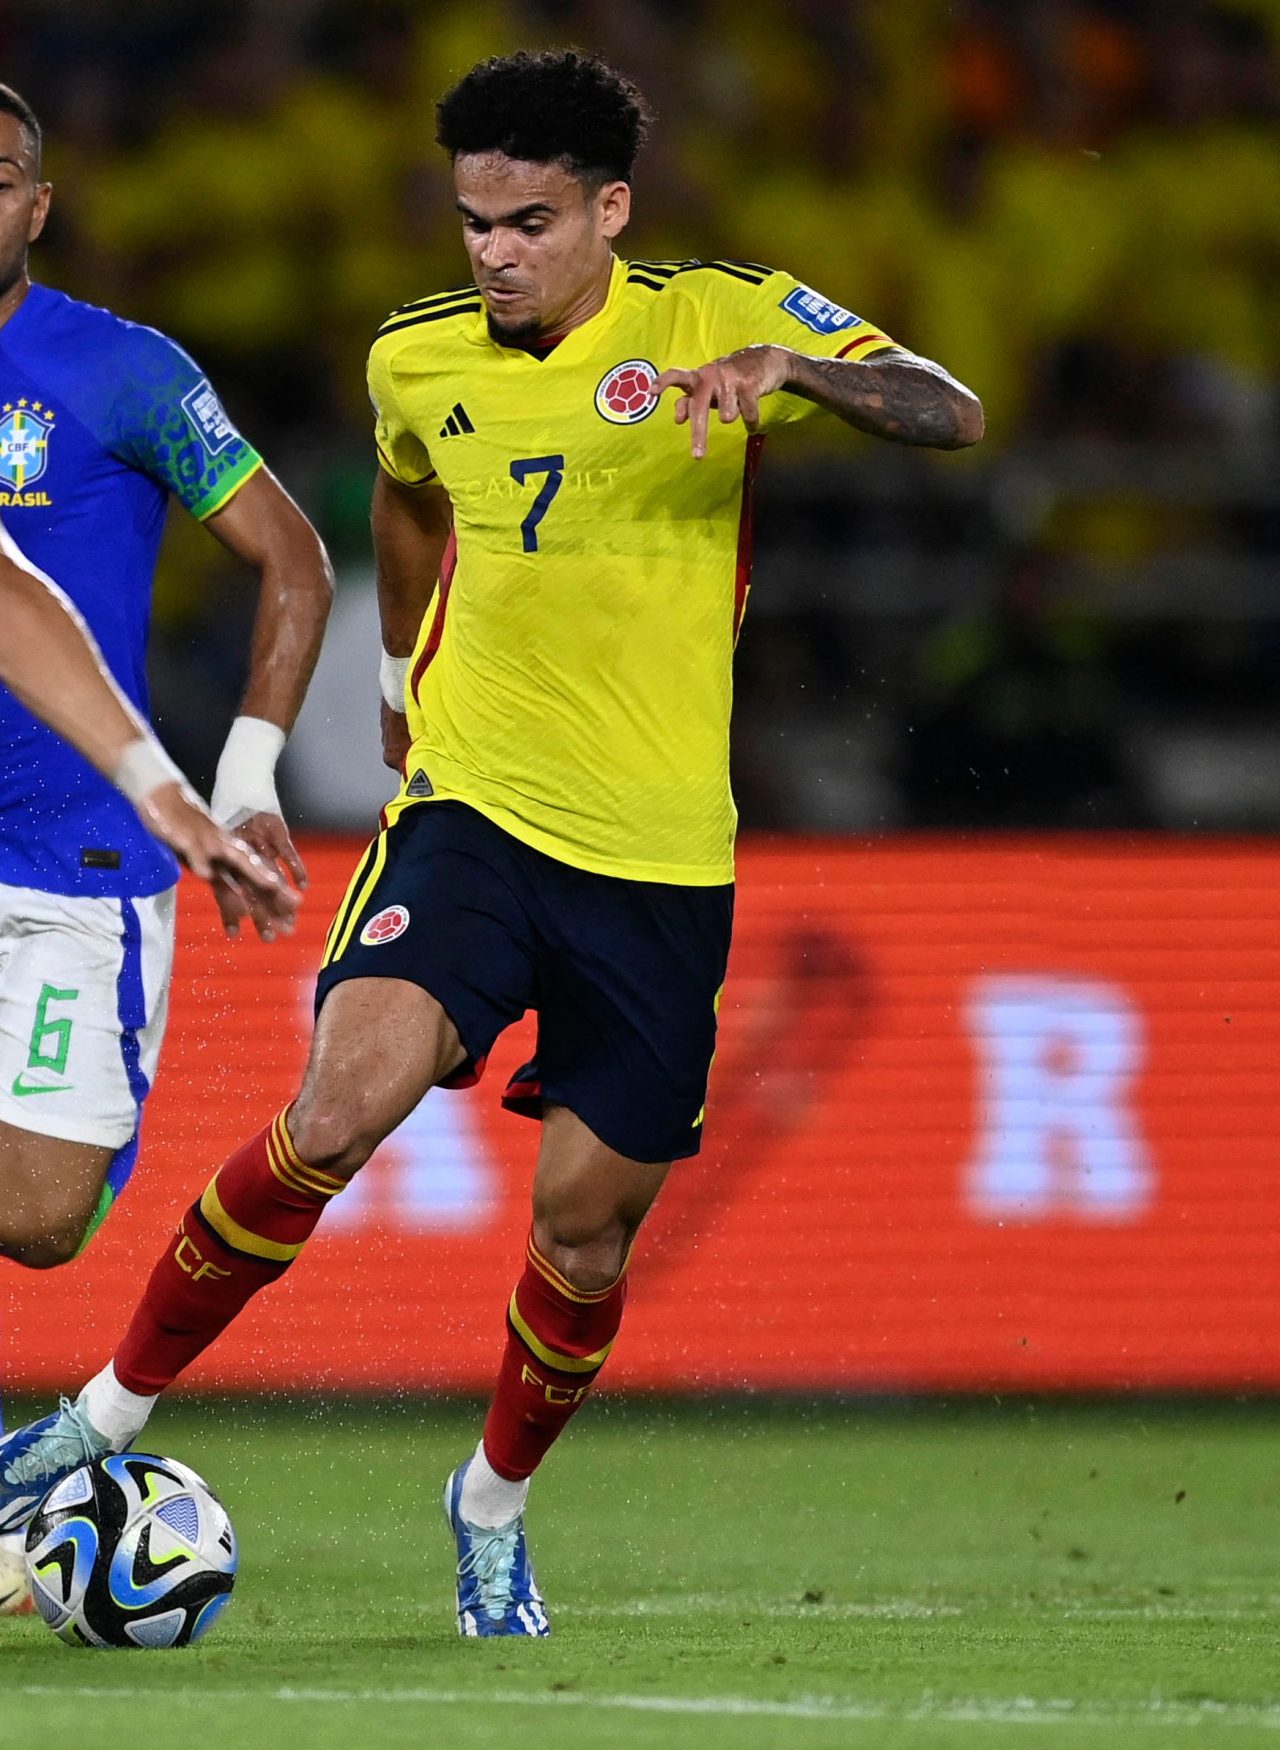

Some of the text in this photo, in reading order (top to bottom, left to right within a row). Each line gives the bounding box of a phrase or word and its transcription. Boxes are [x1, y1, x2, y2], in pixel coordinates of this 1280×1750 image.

[7, 442, 30, 453] CBF
[465, 467, 619, 501] CATAULT
[510, 454, 565, 554] 7
[27, 983, 80, 1075] 6
